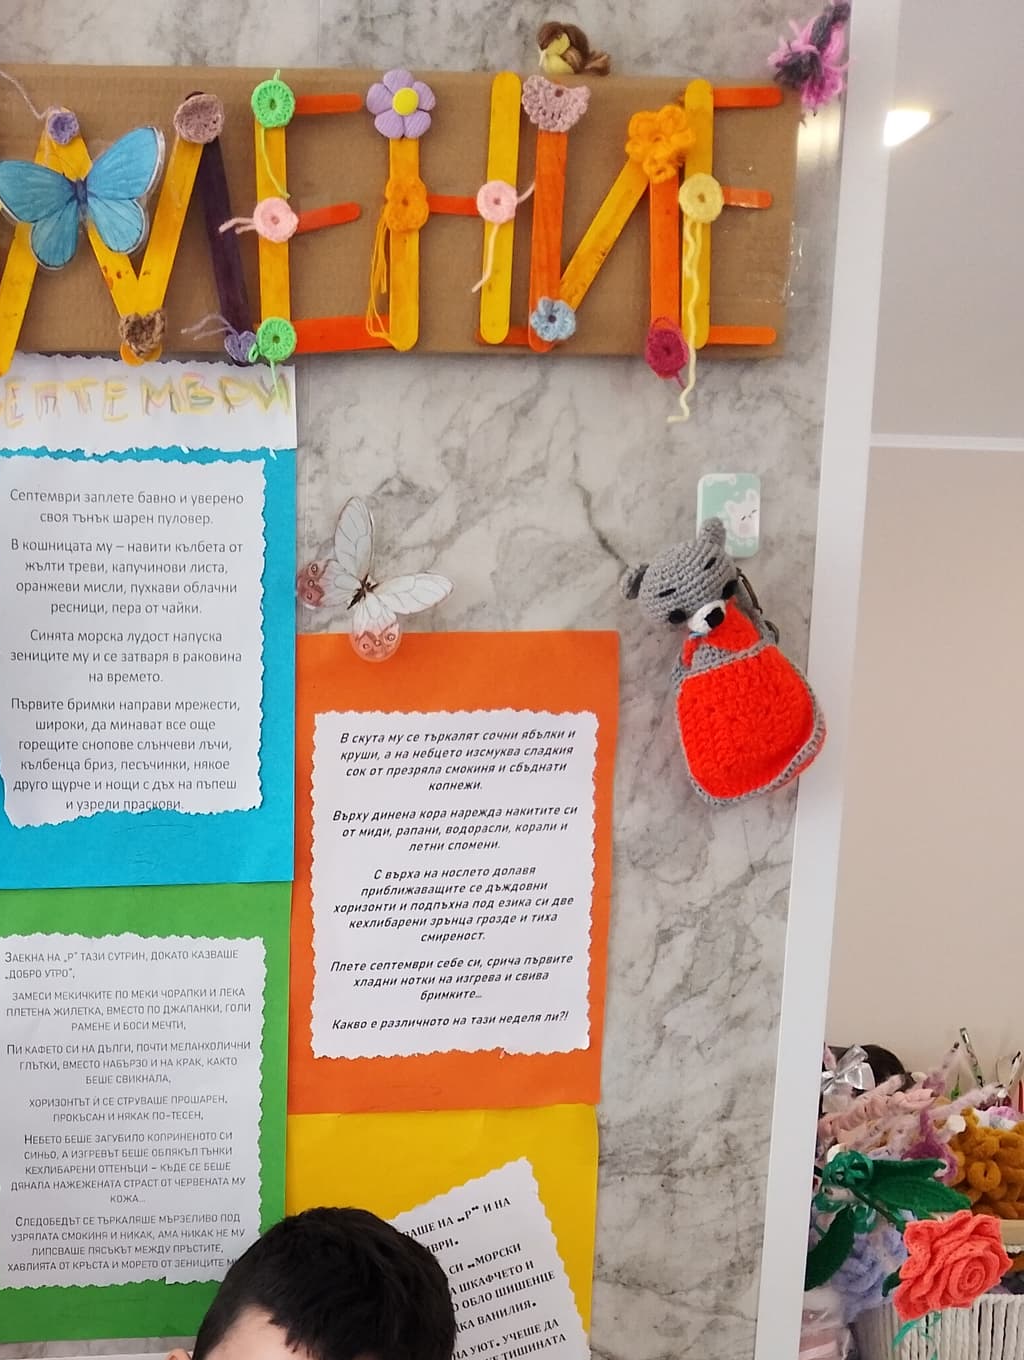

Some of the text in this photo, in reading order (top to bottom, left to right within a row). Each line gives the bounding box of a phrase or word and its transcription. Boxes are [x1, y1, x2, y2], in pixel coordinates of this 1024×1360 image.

[9, 488, 244, 507] Септември заплете бавно и уверено
[39, 512, 69, 523] своя
[71, 512, 109, 524] тънък
[112, 513, 154, 527] шарен
[11, 537, 19, 550] В
[22, 540, 92, 554] кошницата
[95, 541, 113, 555] му
[127, 542, 171, 553] навити
[175, 540, 226, 553] кълбета
[228, 543, 243, 552] от
[24, 561, 65, 572] жълти
[112, 562, 186, 576] капучинови
[15, 581, 80, 594] оранжеви
[130, 583, 180, 596] пухкави
[182, 580, 237, 594] облачни
[111, 603, 141, 616] пера
[144, 603, 159, 614] от
[30, 628, 222, 645] Синята морска лудост напуска
[10, 651, 242, 665] зениците му и се затваря в раковина
[88, 672, 103, 682] на
[19, 740, 78, 753] горещите
[81, 740, 134, 751] снопове
[137, 739, 195, 752] слънчеви
[383, 750, 392, 759] а
[393, 750, 409, 759] на
[411, 747, 463, 759] небцето
[464, 747, 521, 760] изсмуква
[523, 746, 574, 757] сладкия
[20, 756, 81, 773] кълбенца
[193, 759, 230, 770] някое
[345, 761, 567, 778] сок от презряла смокиня и сбъднати
[332, 806, 578, 824] Върху динена кора нарежда накитите си
[341, 828, 357, 837] от
[514, 823, 557, 834] корали
[560, 822, 568, 831] и
[408, 842, 445, 851] летни
[373, 866, 536, 882] С върха на нослето долавя
[360, 882, 548, 899] приближаващите се дъждовни
[348, 913, 558, 930] кехлибарени зрънца грозде и тиха
[330, 960, 367, 972] Плете
[369, 960, 434, 972] септември
[436, 956, 464, 968] себе
[486, 957, 521, 969] срича
[523, 955, 573, 967] първите
[352, 971, 549, 988] хладни нотки на изгрева и свива
[437, 1197, 510, 1229] НА И НА
[448, 1262, 464, 1274] СИ
[458, 1259, 534, 1293] ШКАФЧЕТО И
[461, 1271, 555, 1309] ОБЛО ШИШЕНЦЕ
[501, 1323, 542, 1345] УЧЕШЕ
[543, 1318, 559, 1332] ДА
[500, 1333, 566, 1360] ТИШИНАТА
